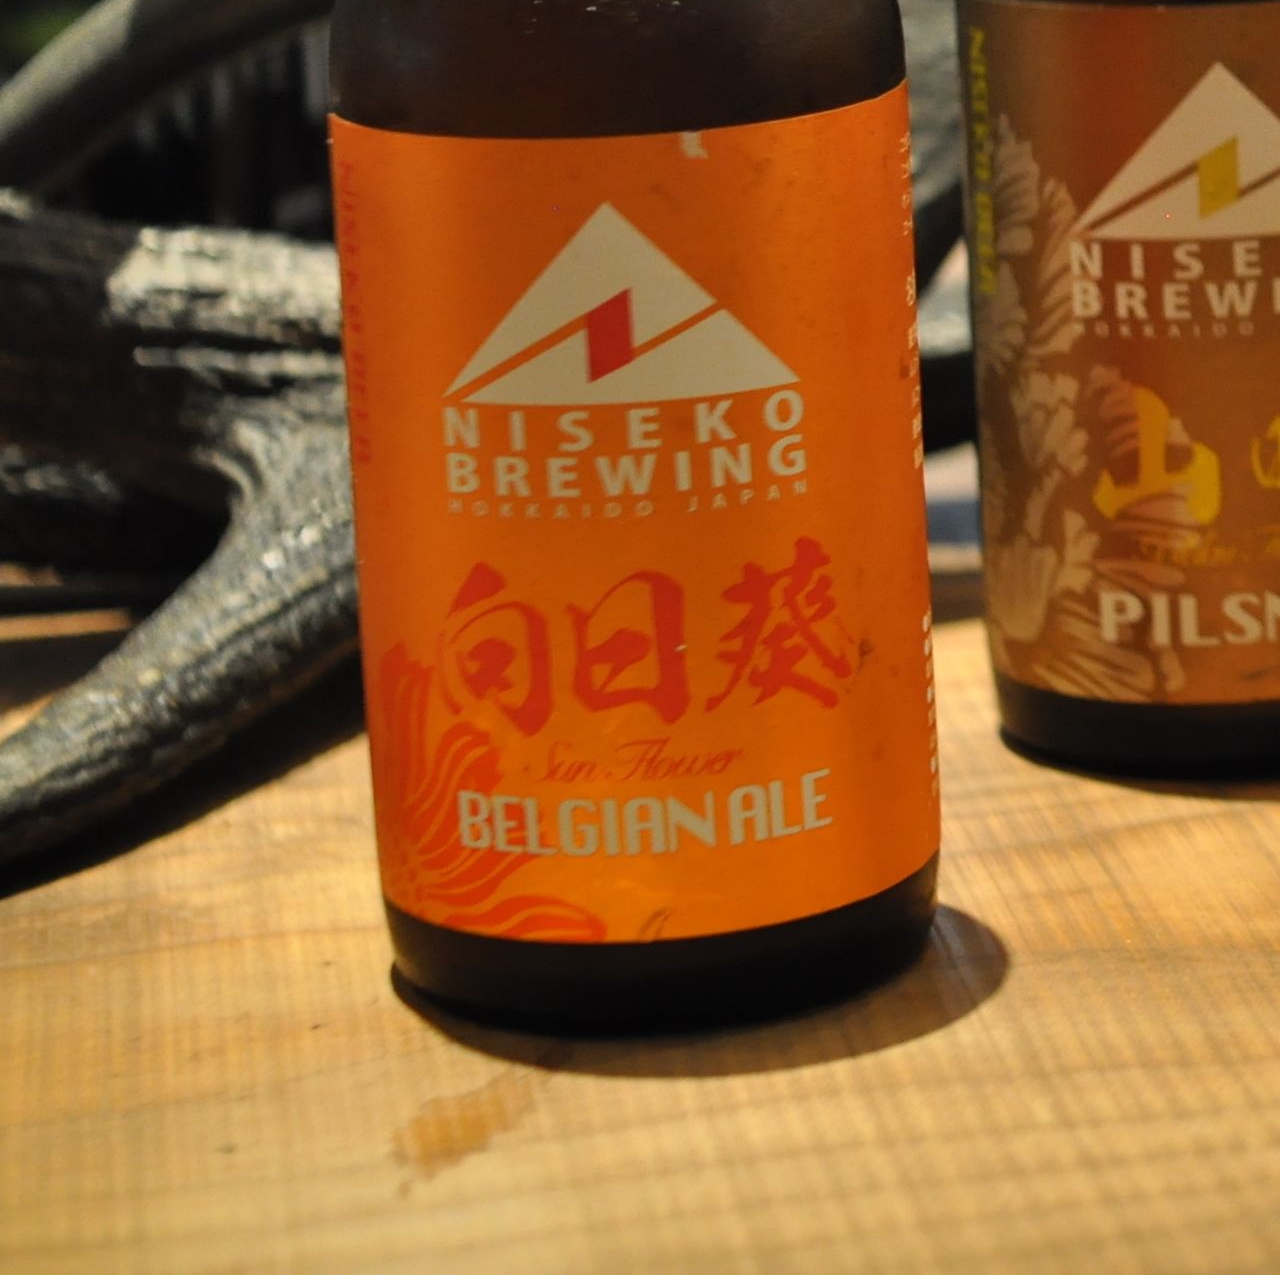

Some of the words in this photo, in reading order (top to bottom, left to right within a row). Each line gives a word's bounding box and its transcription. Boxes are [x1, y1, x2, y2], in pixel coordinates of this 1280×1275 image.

[442, 389, 805, 452] NISEKO
[446, 434, 808, 498] BREWING
[449, 498, 655, 520] HOKKAIDO
[686, 478, 808, 513] JAPAN
[437, 536, 852, 737] 向日葵
[522, 740, 597, 783] Sun
[604, 737, 747, 782] Flower
[456, 789, 719, 857] BELGIAN
[727, 768, 833, 846] ALE
